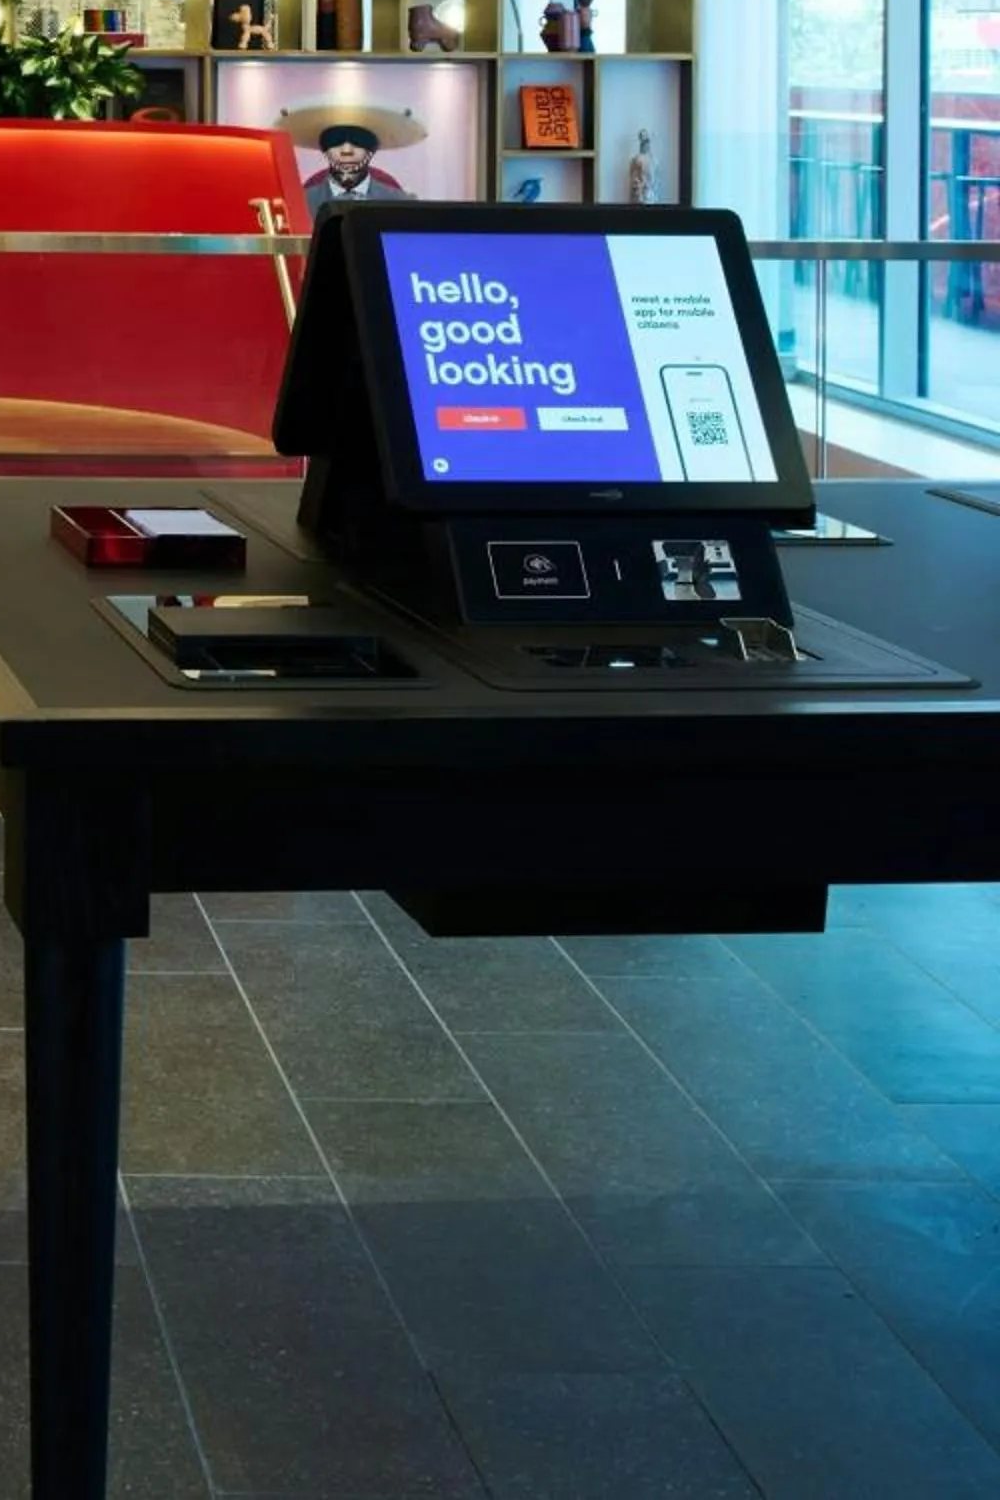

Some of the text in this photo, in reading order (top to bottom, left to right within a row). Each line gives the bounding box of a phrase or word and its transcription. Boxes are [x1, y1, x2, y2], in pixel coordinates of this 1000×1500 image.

[535, 87, 553, 137] rams
[551, 87, 571, 142] dieter
[410, 271, 519, 309] hello,
[419, 312, 522, 353] good
[634, 309, 657, 318] app
[659, 307, 673, 317] for
[425, 352, 577, 395] looking
